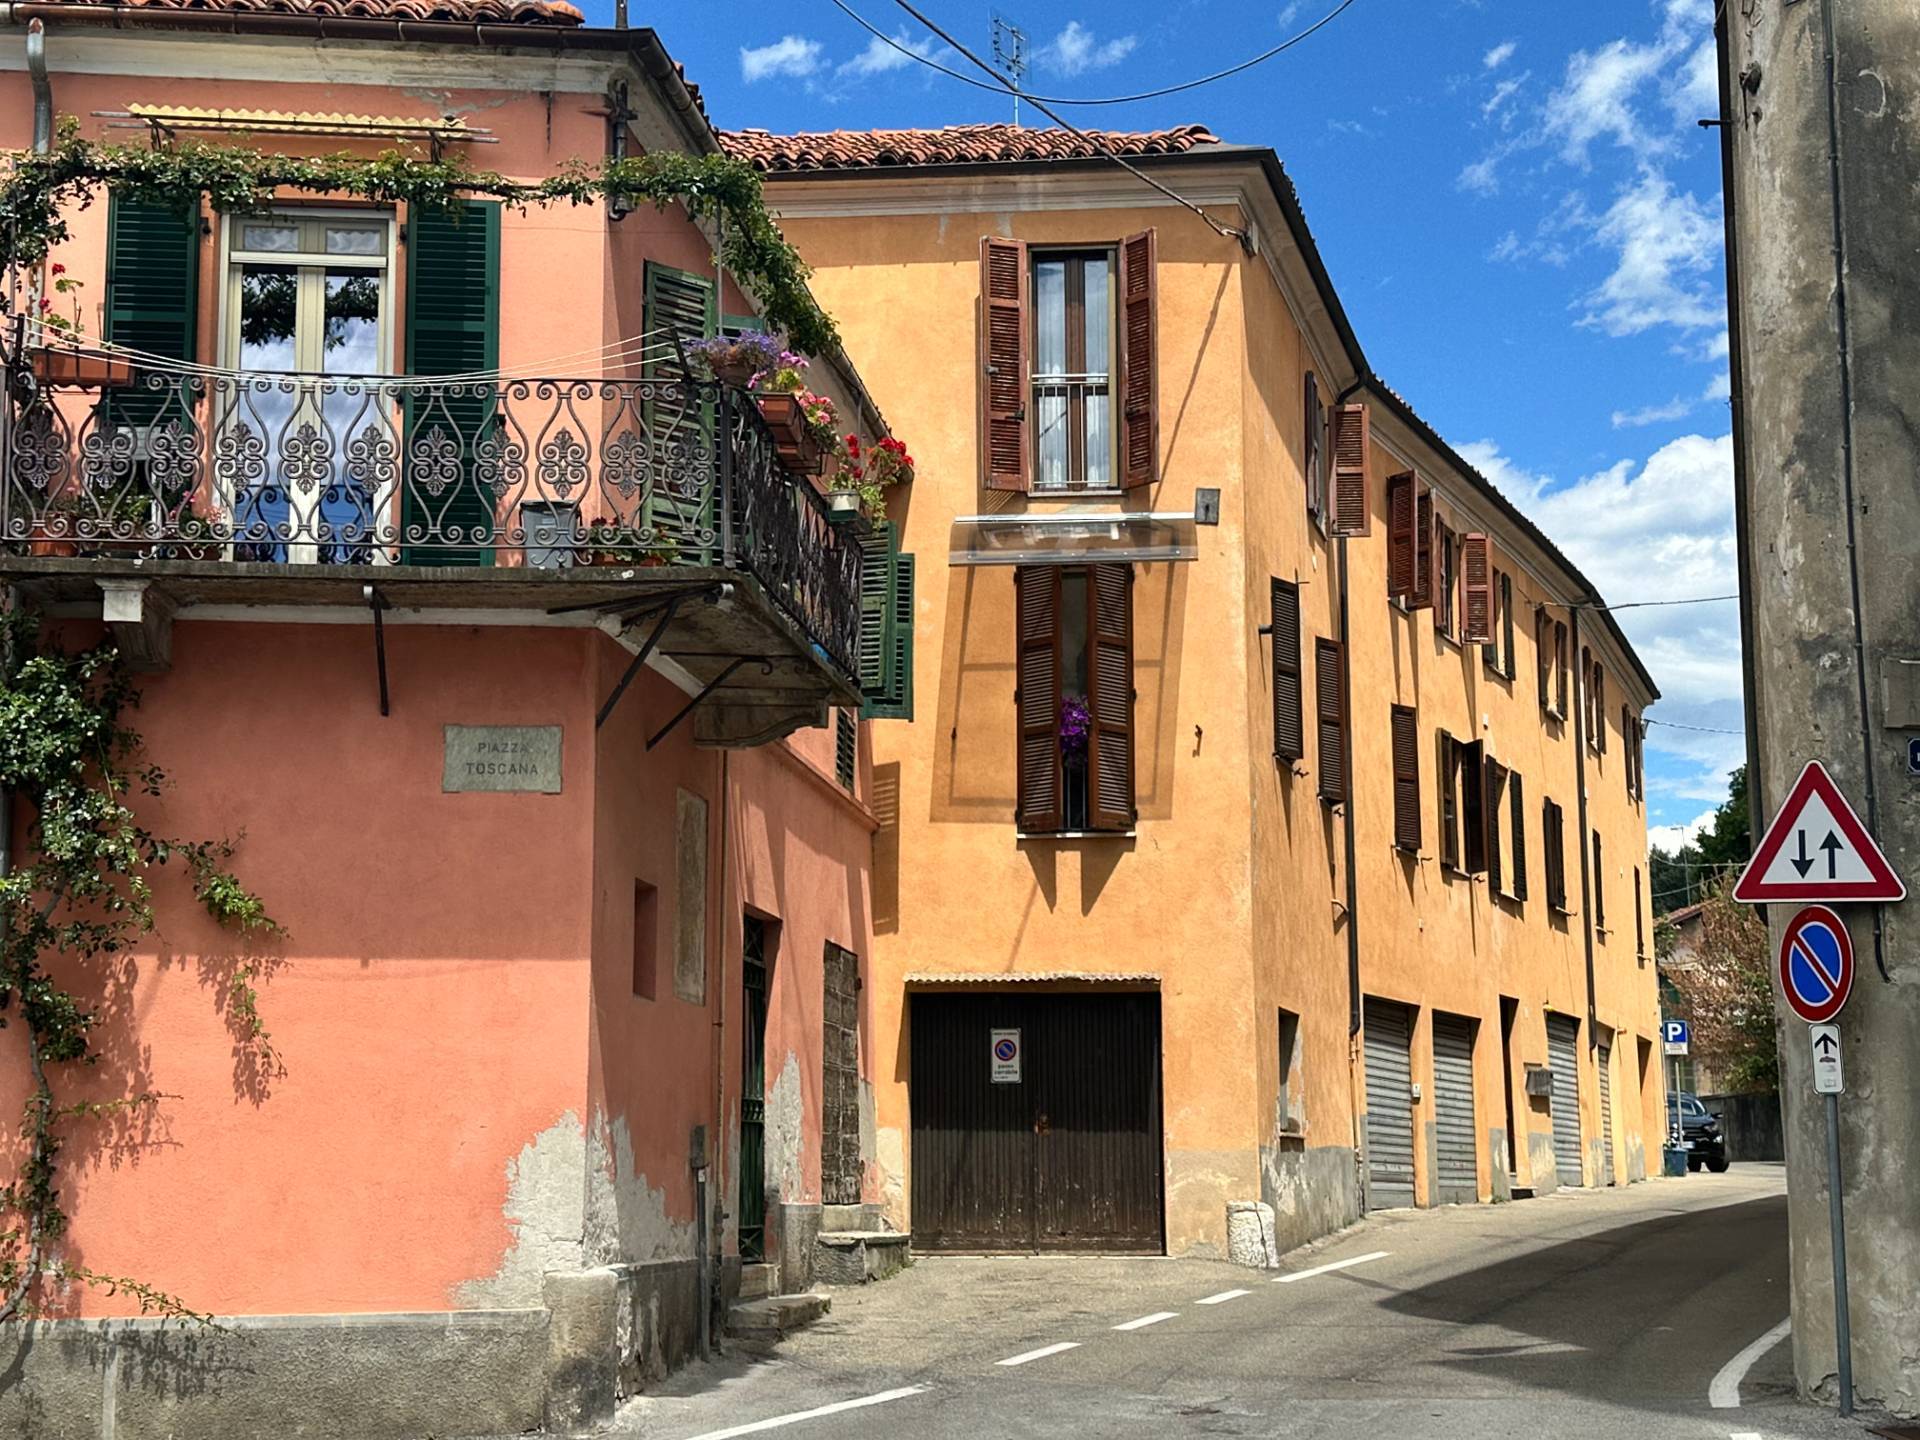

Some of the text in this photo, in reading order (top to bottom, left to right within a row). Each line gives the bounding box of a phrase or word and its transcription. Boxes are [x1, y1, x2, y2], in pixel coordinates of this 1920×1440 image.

[477, 742, 530, 753] PIAZZA
[466, 762, 539, 775] TOSCANA
[1668, 1023, 1682, 1041] P
